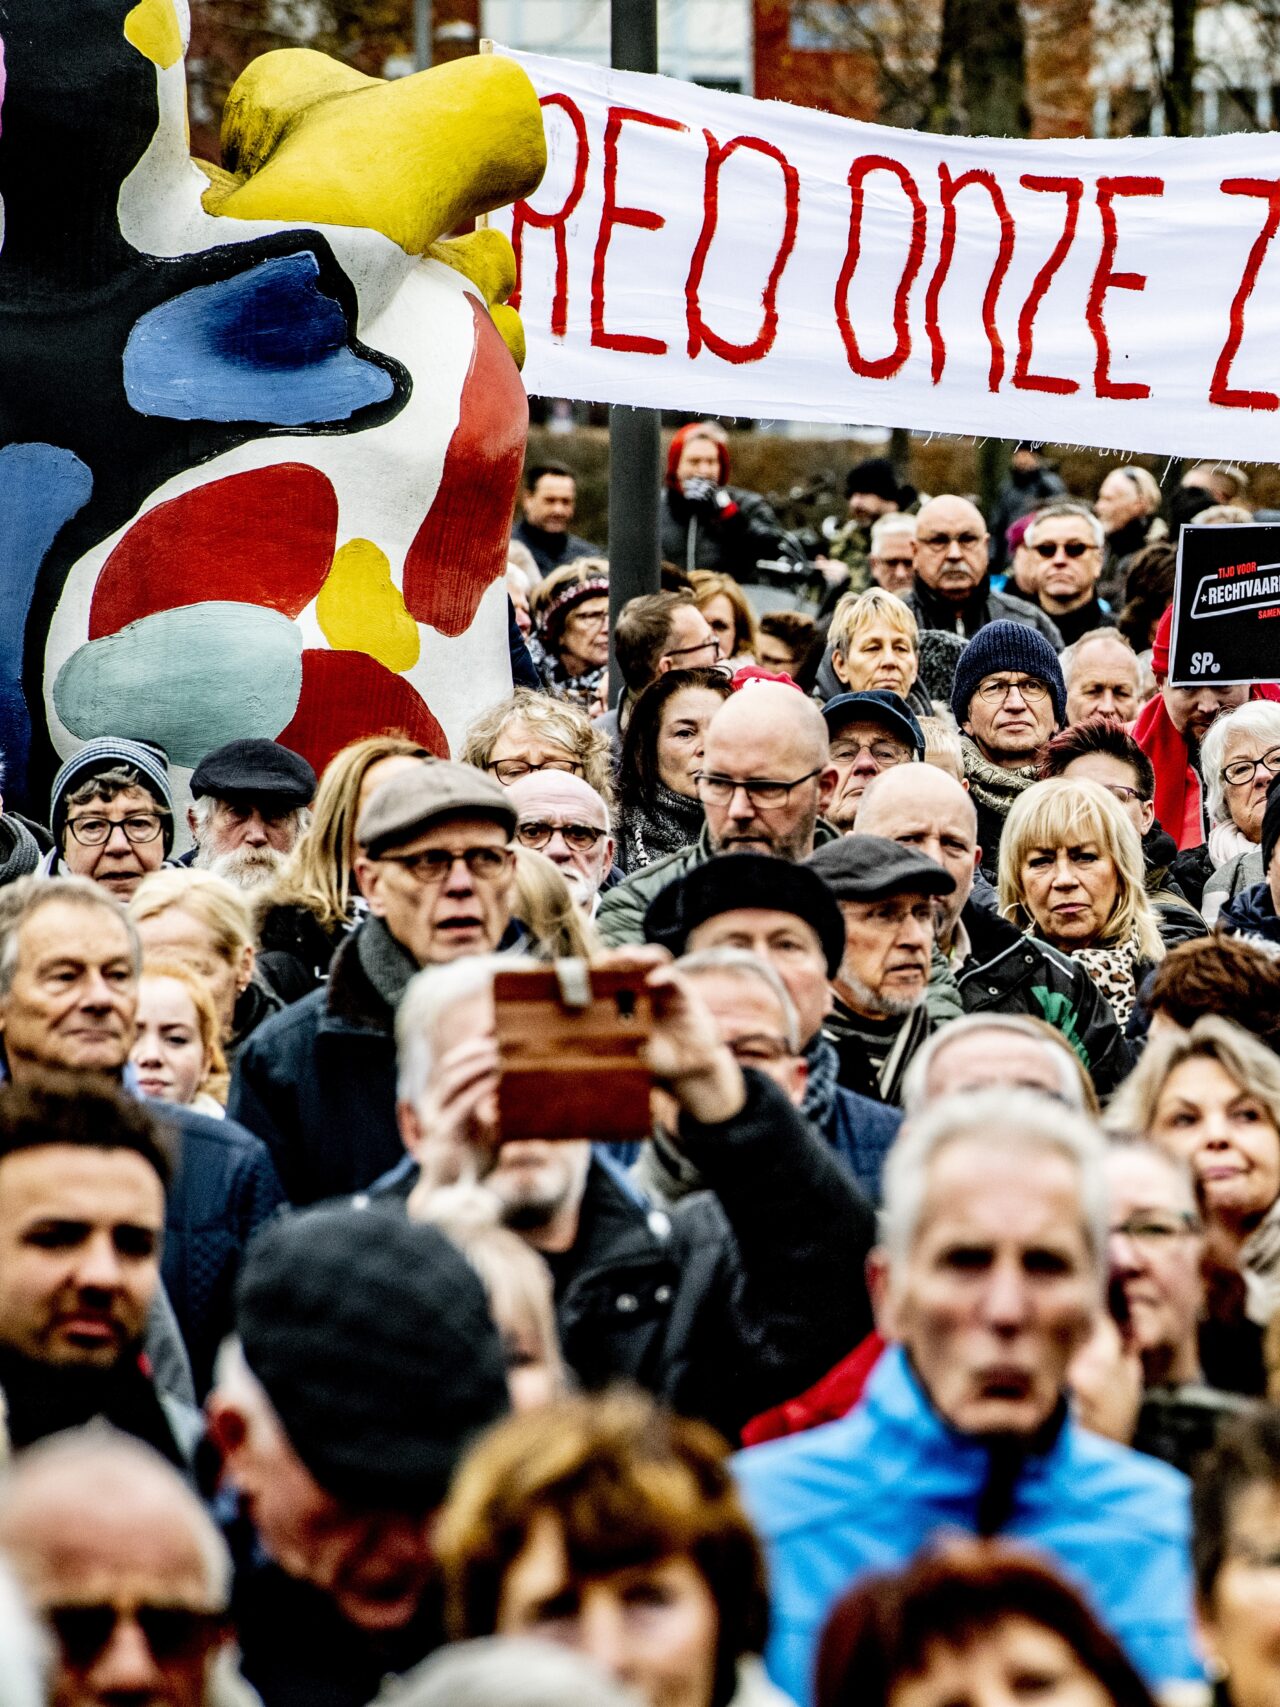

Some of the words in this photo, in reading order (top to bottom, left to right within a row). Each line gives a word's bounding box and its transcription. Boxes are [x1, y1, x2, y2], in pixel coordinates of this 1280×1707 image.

[508, 93, 800, 364] RED
[1218, 567, 1235, 579] TIJD
[1236, 562, 1257, 576] VOOR
